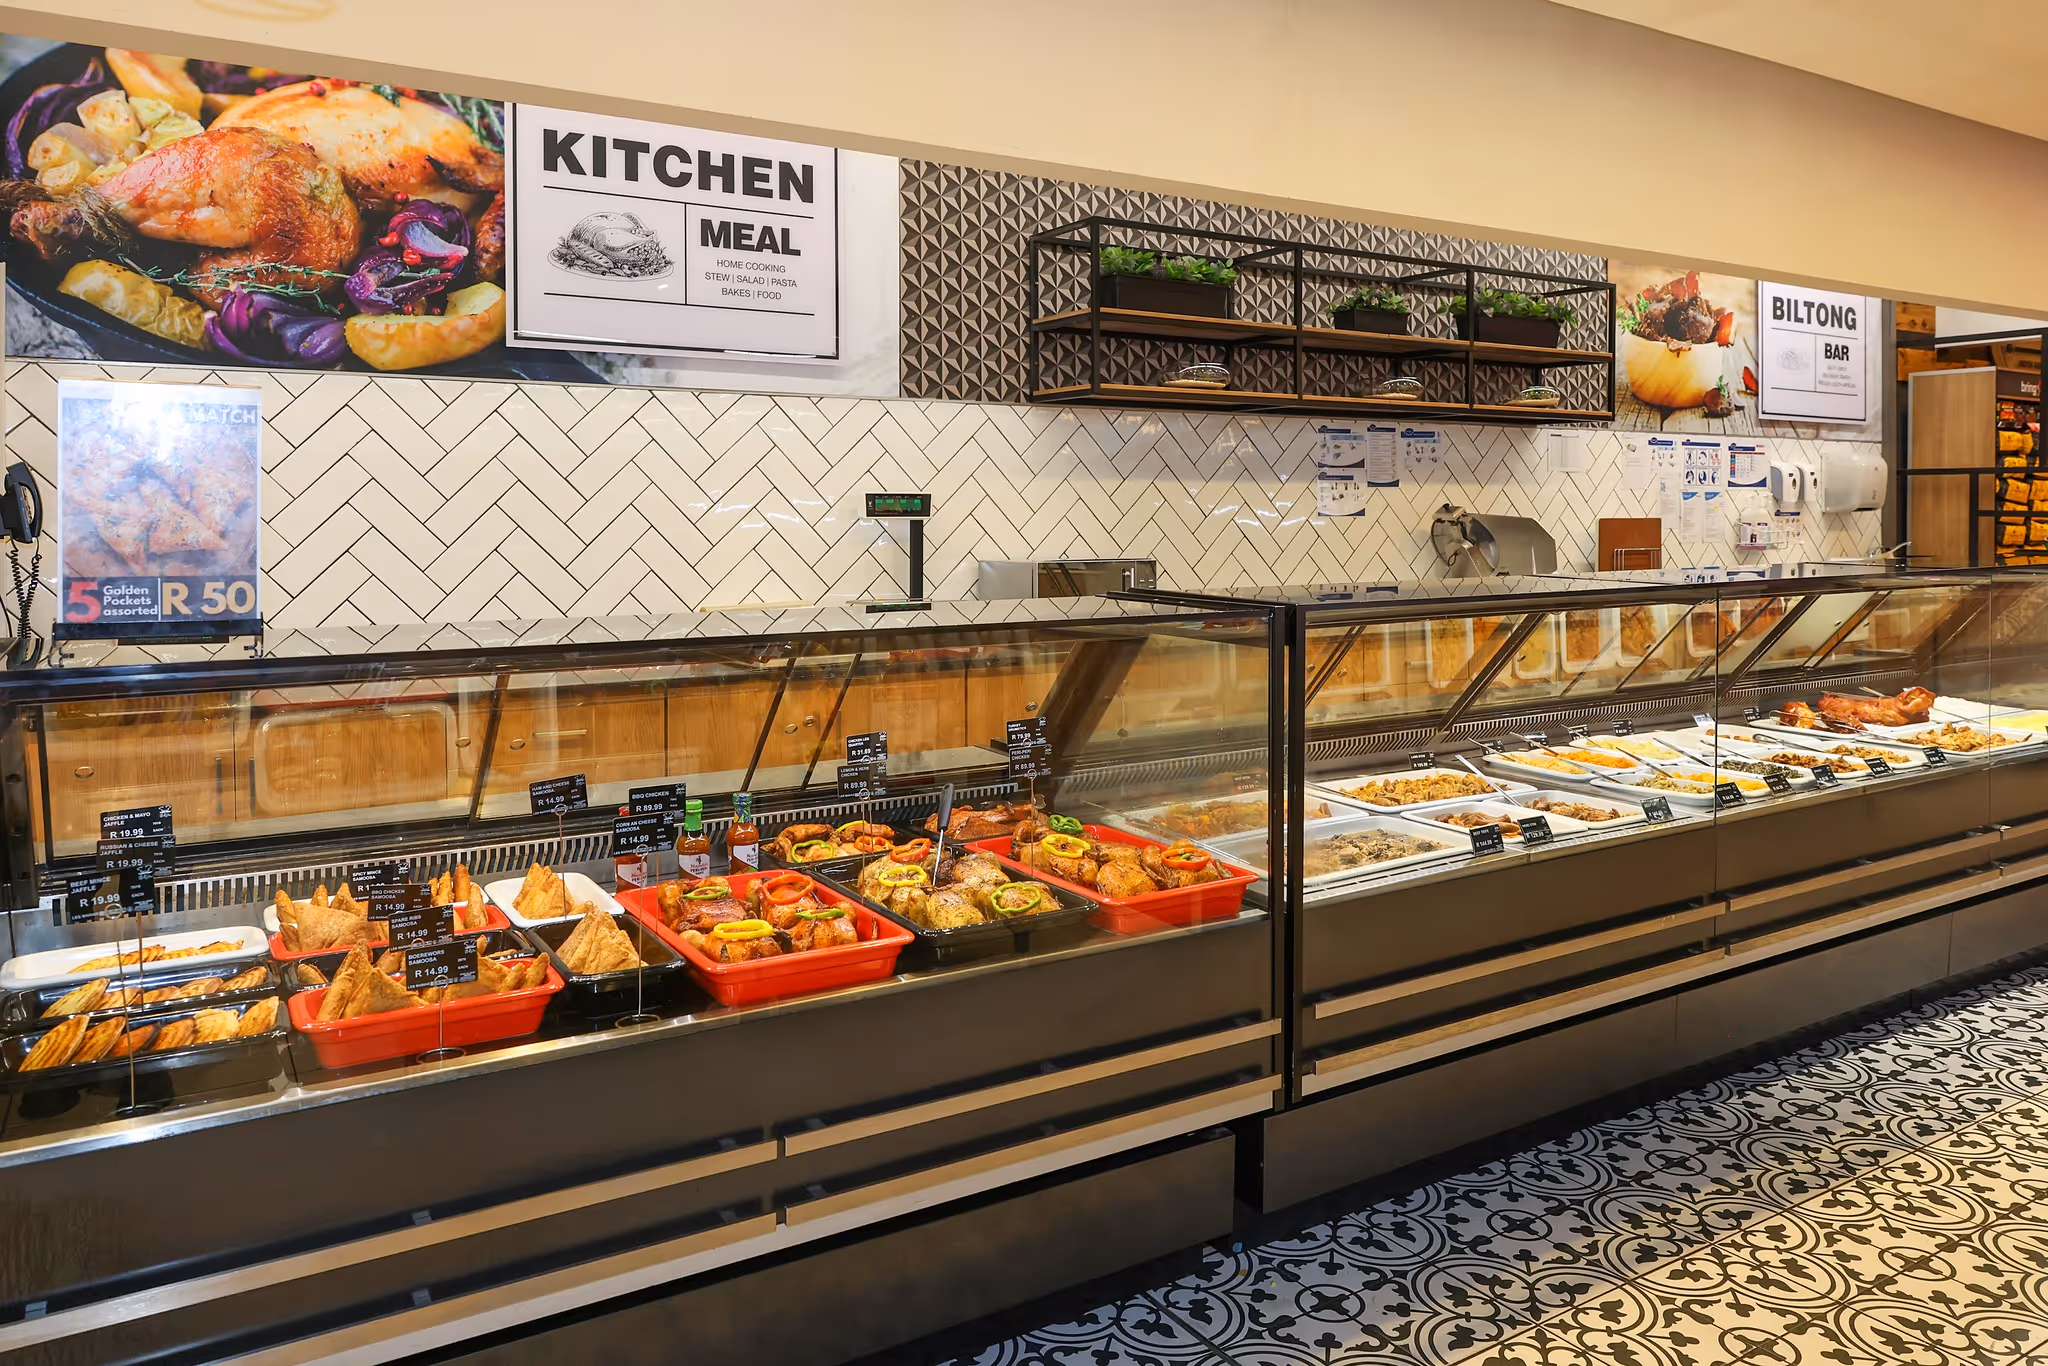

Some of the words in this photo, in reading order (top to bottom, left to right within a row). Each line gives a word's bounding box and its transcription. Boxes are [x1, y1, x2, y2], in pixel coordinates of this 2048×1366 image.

[544, 128, 814, 203] KITCHEN
[700, 218, 801, 256] MEAL
[716, 259, 742, 270] HOME
[745, 261, 785, 274] COOKING
[704, 272, 730, 282] STEW
[736, 274, 765, 285] SALAD
[771, 277, 797, 288] PASTA
[722, 287, 751, 298] BAKES
[757, 290, 781, 300] FOOD
[1773, 296, 1856, 331] BILTONG
[1825, 342, 1849, 361] BAR
[103, 585, 149, 596] Golden
[64, 581, 102, 624] 5
[103, 596, 152, 606] Pockets
[162, 582, 193, 615] R
[202, 581, 256, 615] 50
[103, 606, 158, 616] assorted
[545, 796, 565, 805] 14.99
[643, 803, 663, 811] 89.99
[103, 814, 129, 822] CHICKEN
[637, 818, 657, 826] CHEESE
[103, 820, 125, 828] JAFFLE
[120, 828, 144, 837] 19.99
[615, 826, 640, 834] SAMOOSA
[628, 835, 649, 844] 14.99
[117, 859, 143, 867] 19.99
[70, 880, 88, 888] BEEF
[90, 876, 111, 884] MINCE
[71, 885, 96, 894] JAFFLE
[80, 899, 89, 907] R
[91, 894, 120, 905] 19.99
[391, 916, 408, 924] SPARE
[391, 921, 418, 929] SAMOOSA
[406, 929, 428, 939] 14.99
[408, 950, 445, 959] BOEREWORS
[408, 957, 437, 966] SAMOOSA
[415, 969, 422, 978] R
[424, 966, 448, 976] 14.99
